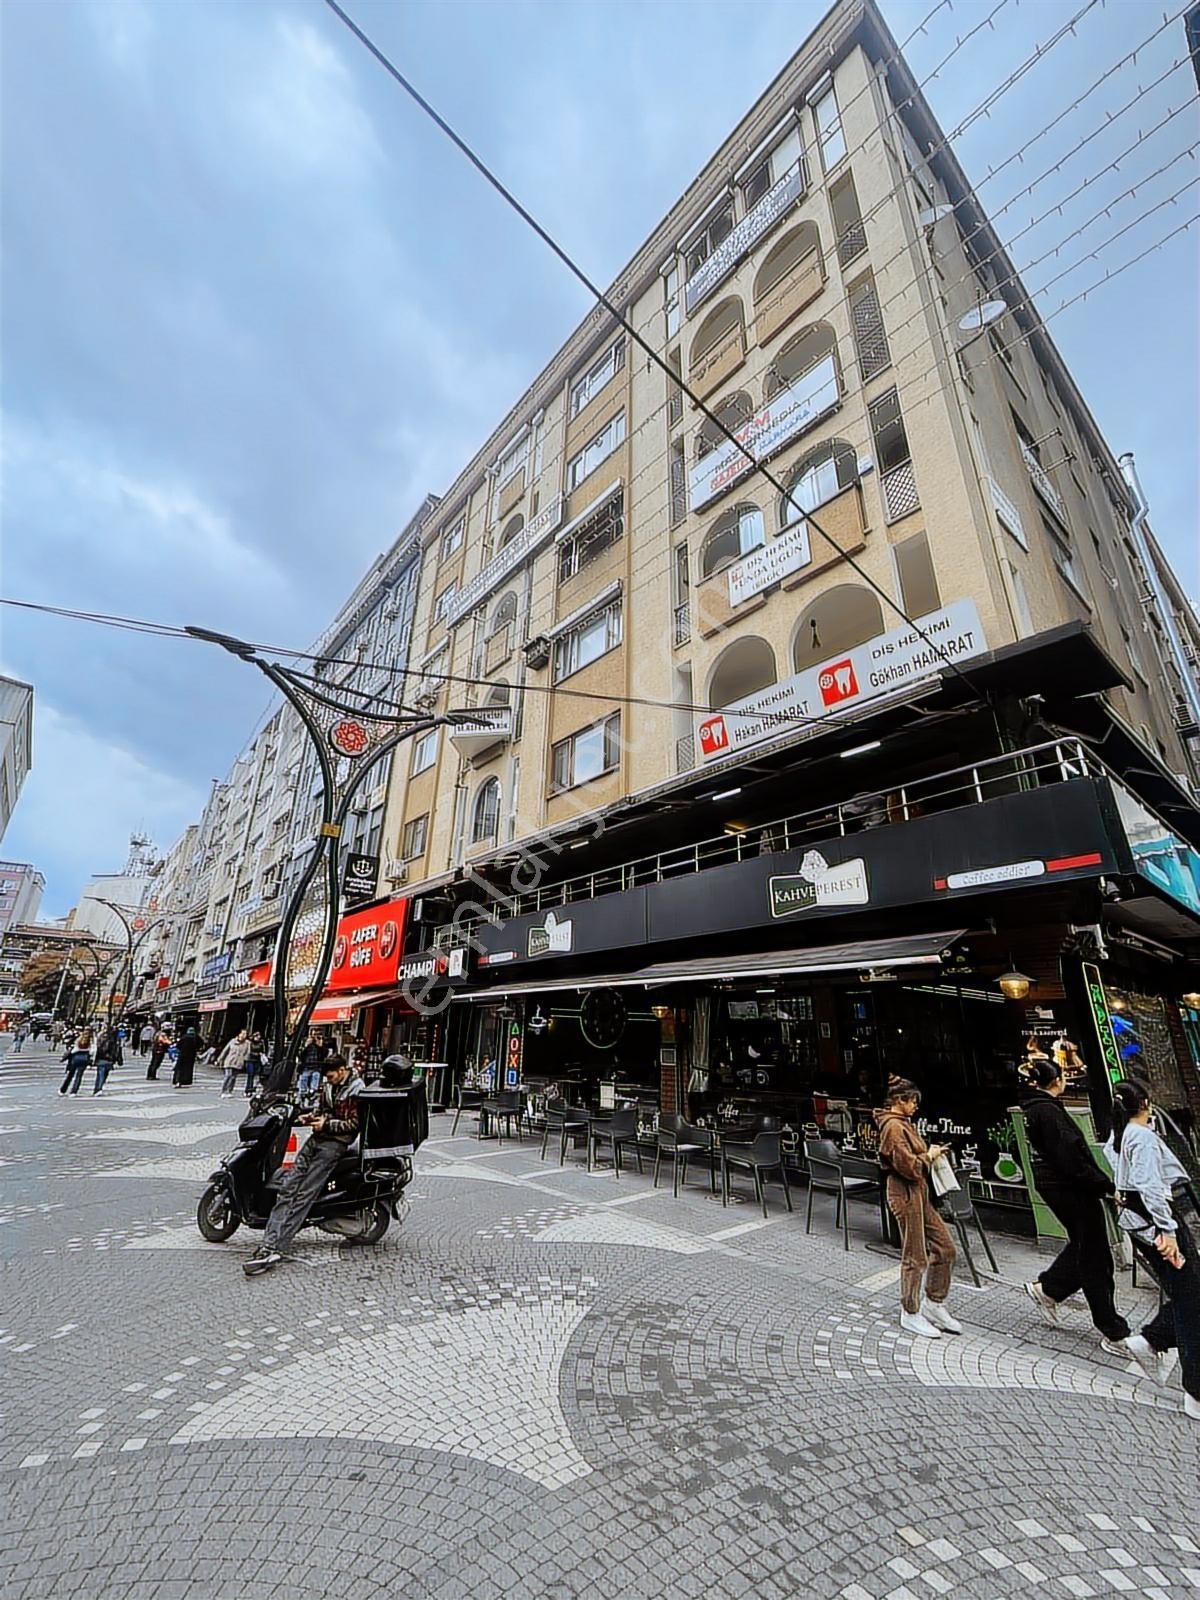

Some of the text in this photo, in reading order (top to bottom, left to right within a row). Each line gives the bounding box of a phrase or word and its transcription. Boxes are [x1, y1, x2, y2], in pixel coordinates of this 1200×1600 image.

[869, 632, 973, 687] Gökhan HAMARAT
[734, 700, 810, 742] Hakan HAMARAT
[939, 1117, 973, 1135] Time
